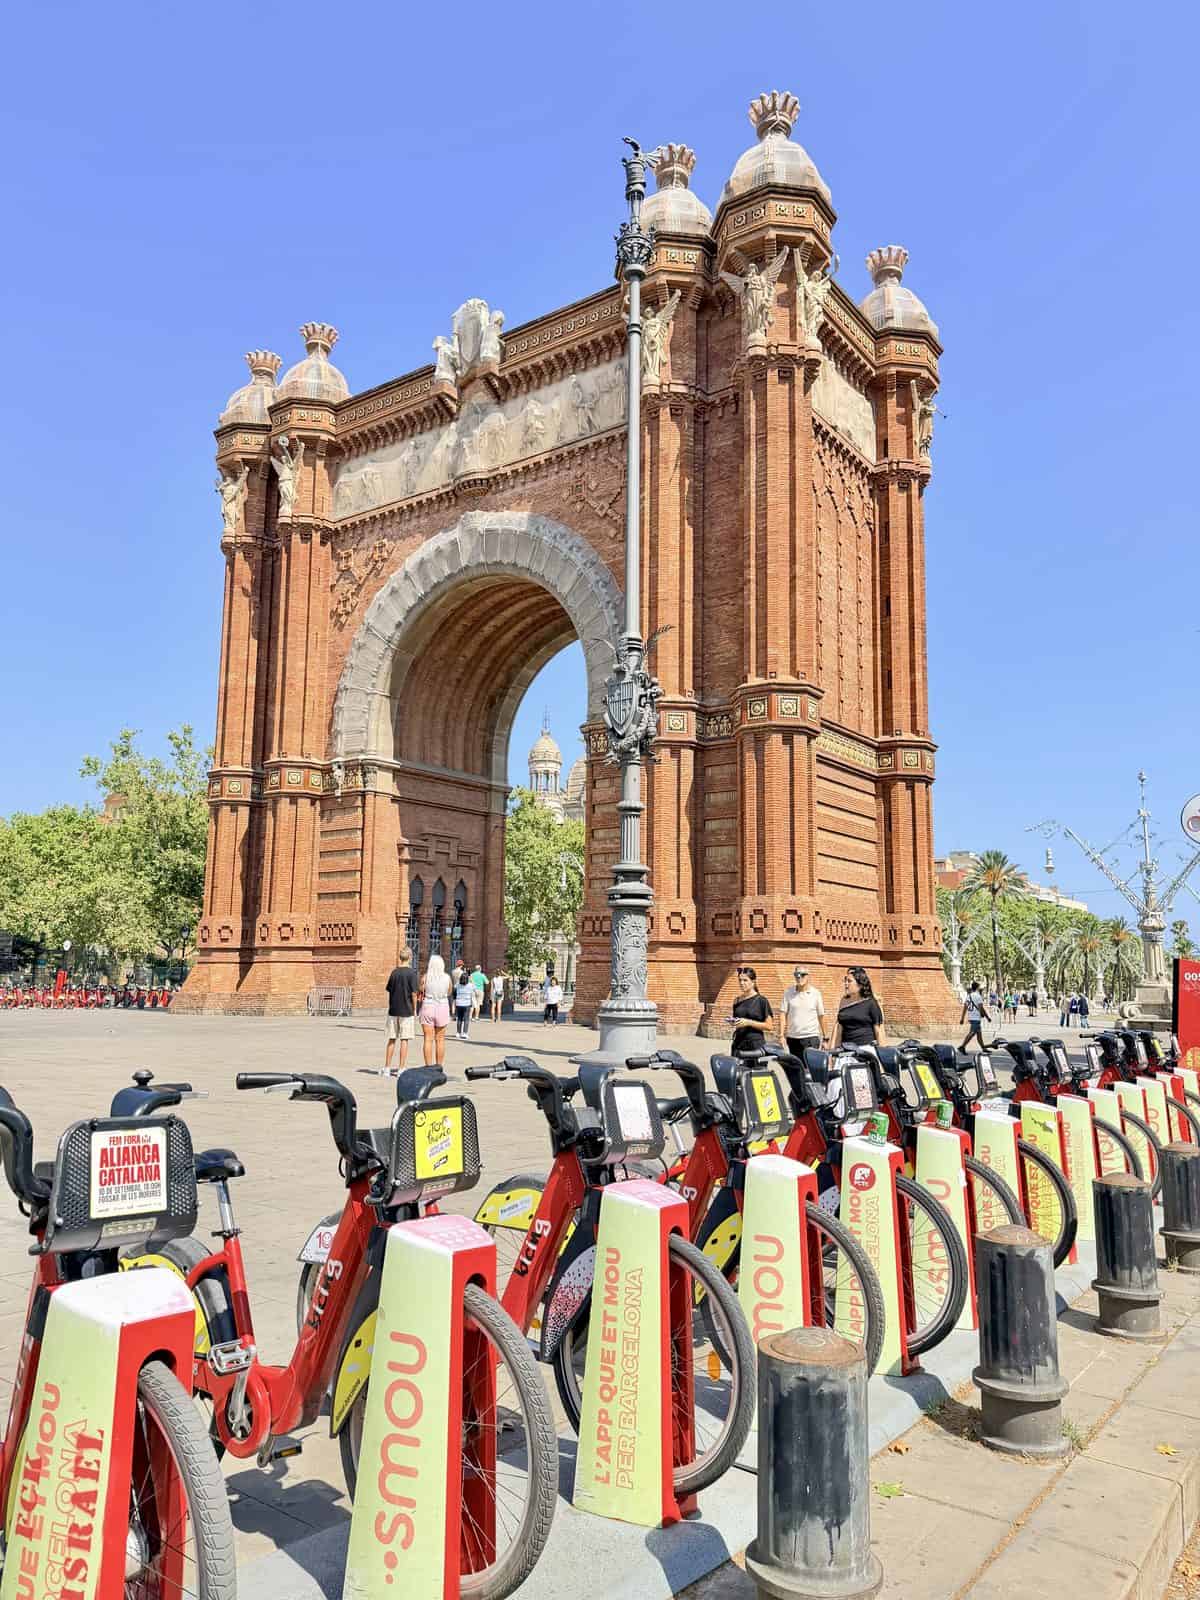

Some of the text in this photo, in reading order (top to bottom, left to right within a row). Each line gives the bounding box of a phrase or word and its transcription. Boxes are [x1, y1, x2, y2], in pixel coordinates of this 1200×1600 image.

[98, 1164, 161, 1187] CATALANA
[594, 1247, 622, 1487] L'APP QUE ET MOU
[615, 1265, 644, 1490] PER BARCELONA
[60, 1429, 105, 1600] ISRAEL
